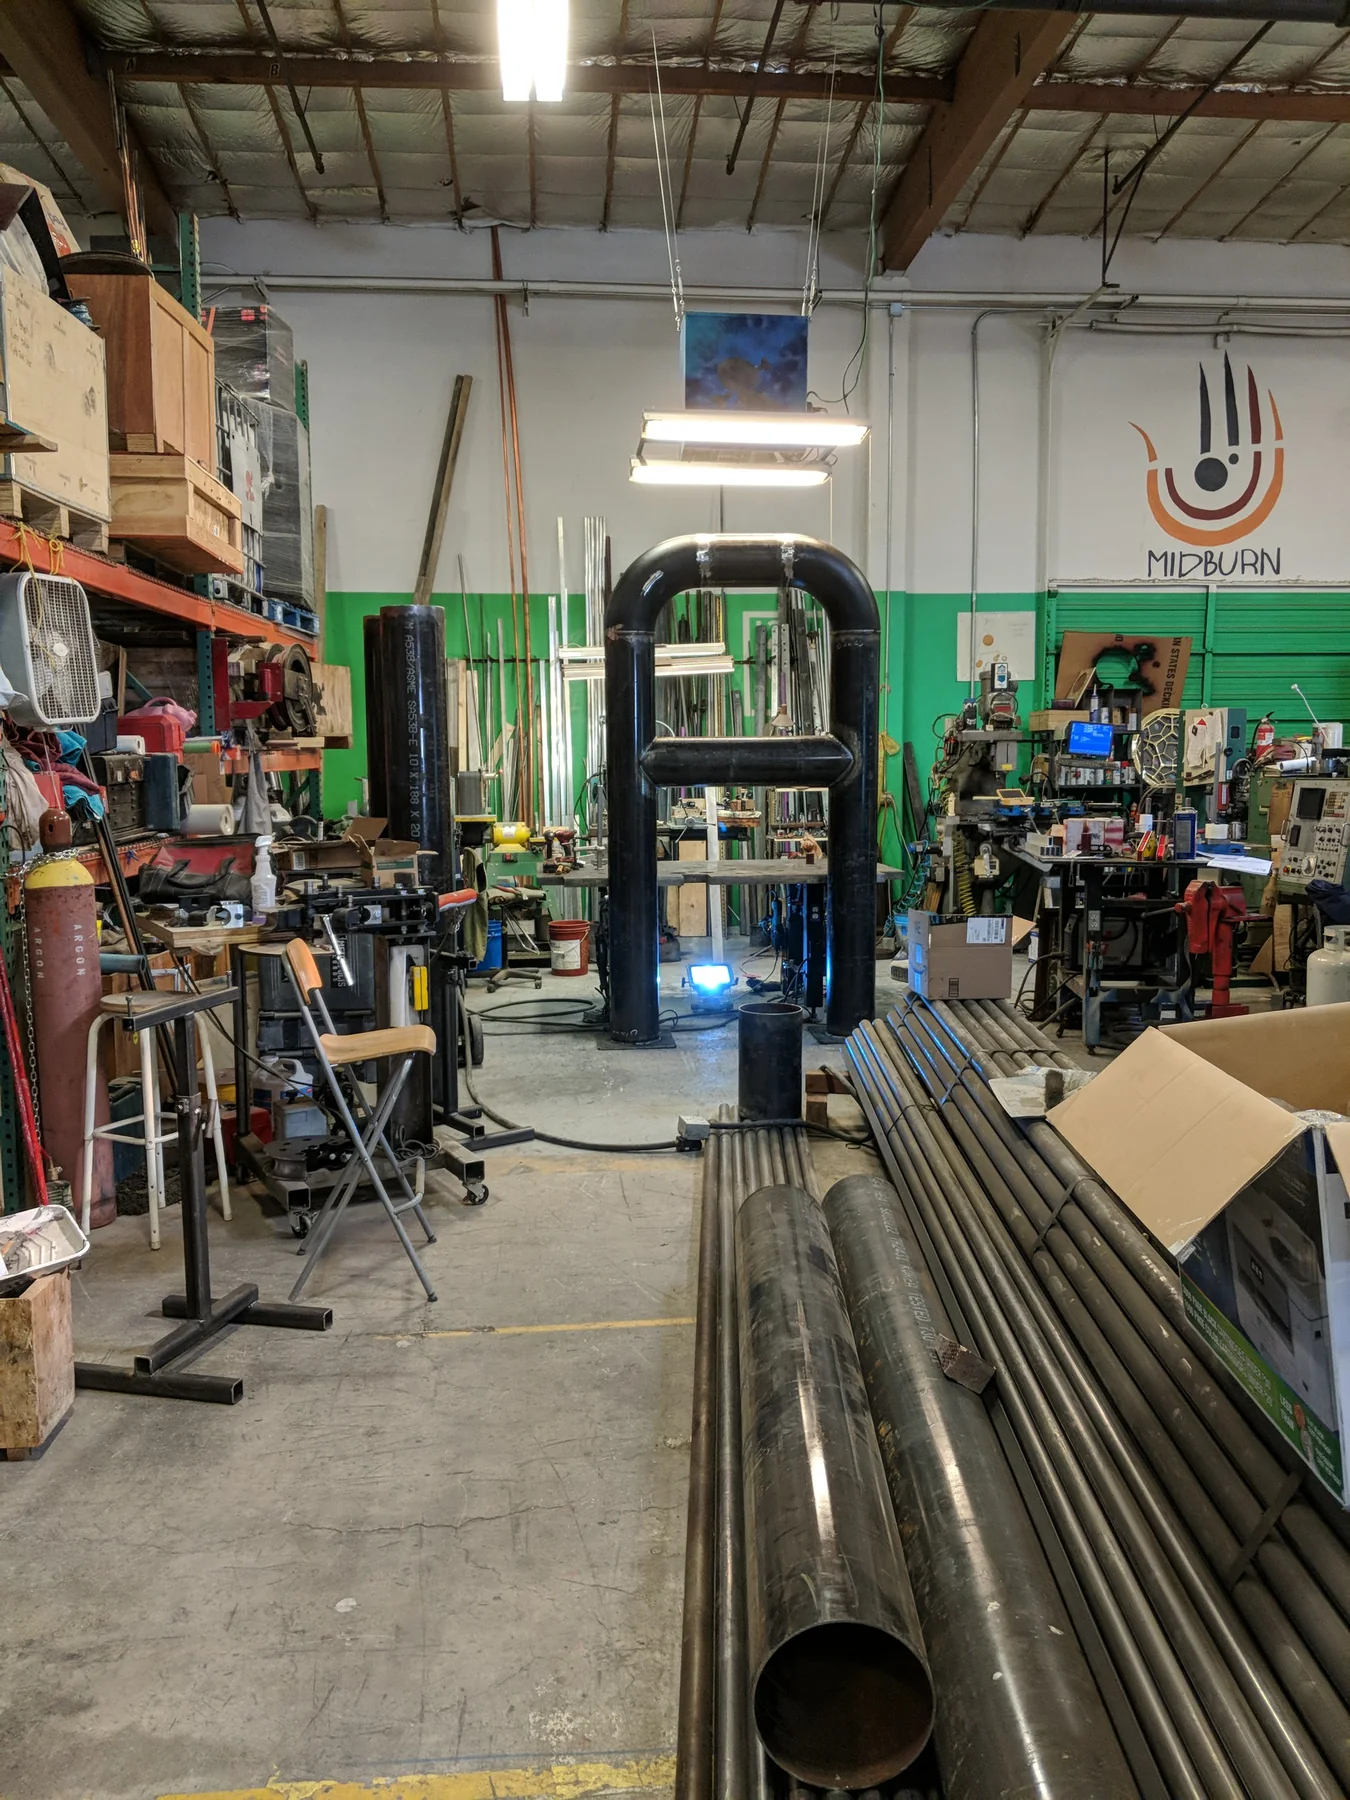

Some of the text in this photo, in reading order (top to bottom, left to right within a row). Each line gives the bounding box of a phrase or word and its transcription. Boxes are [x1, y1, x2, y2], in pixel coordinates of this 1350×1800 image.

[1147, 547, 1281, 578] MIDBURN
[1166, 648, 1181, 679] STATES
[33, 927, 44, 979] ARGON
[73, 924, 86, 976] ARGON
